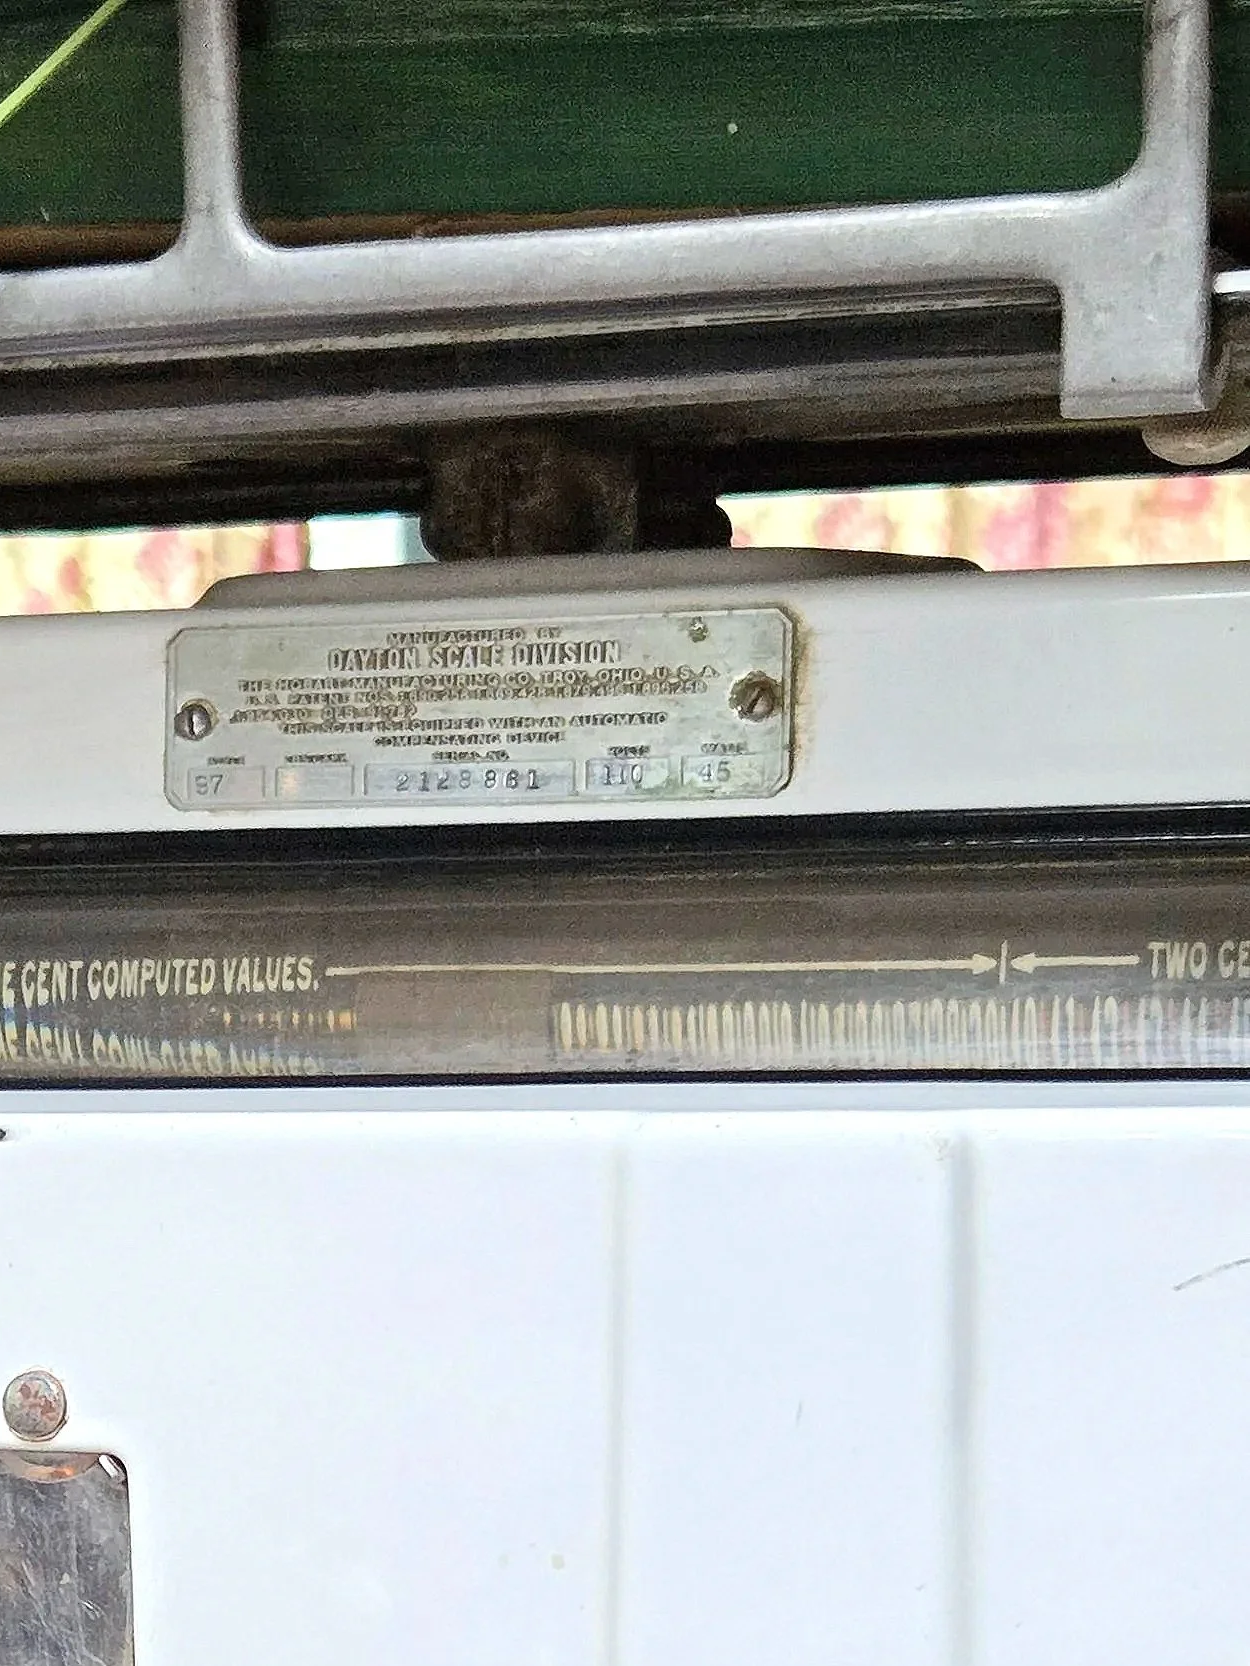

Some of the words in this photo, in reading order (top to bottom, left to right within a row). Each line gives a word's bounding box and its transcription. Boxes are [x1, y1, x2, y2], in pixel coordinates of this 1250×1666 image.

[386, 628, 526, 644] MANUFACTURED
[537, 626, 562, 639] BY
[327, 647, 420, 672] DAYTON
[428, 644, 504, 670] SCALE
[513, 640, 622, 666] DIVISION
[238, 679, 272, 692] THE
[350, 672, 500, 689] MANUFACTURING
[569, 711, 668, 727] AUTOMATIC
[1148, 941, 1207, 980] TWO
[21, 960, 84, 1008] CENT
[87, 957, 216, 1000] COMPUTED
[223, 955, 320, 996] VALUES.
